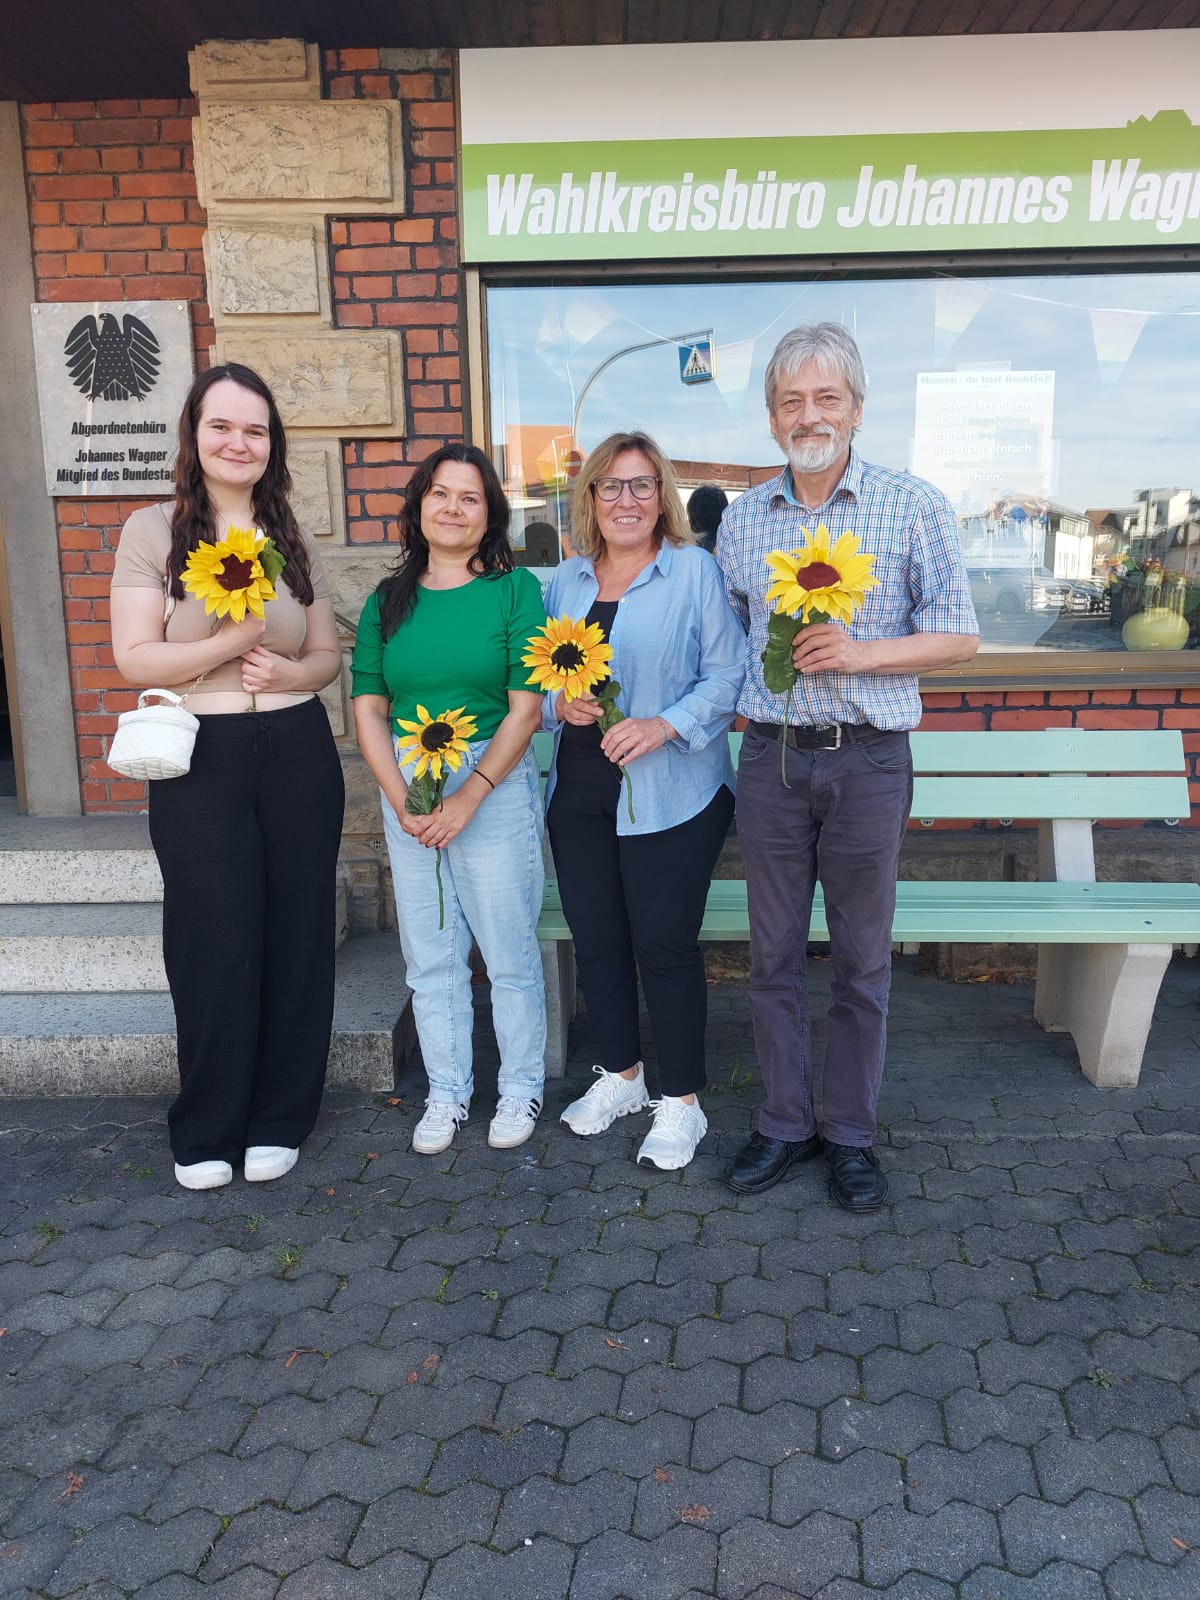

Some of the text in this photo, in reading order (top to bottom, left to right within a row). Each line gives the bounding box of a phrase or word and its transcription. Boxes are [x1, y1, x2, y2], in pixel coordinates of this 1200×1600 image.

[486, 169, 826, 236] Wahlkreisbüro
[836, 164, 1070, 229] Johannes
[71, 421, 167, 437] Abgeordnetenbüro
[75, 448, 168, 464] Johannes Wagner
[56, 468, 99, 484] Mitglied
[101, 468, 120, 481] des
